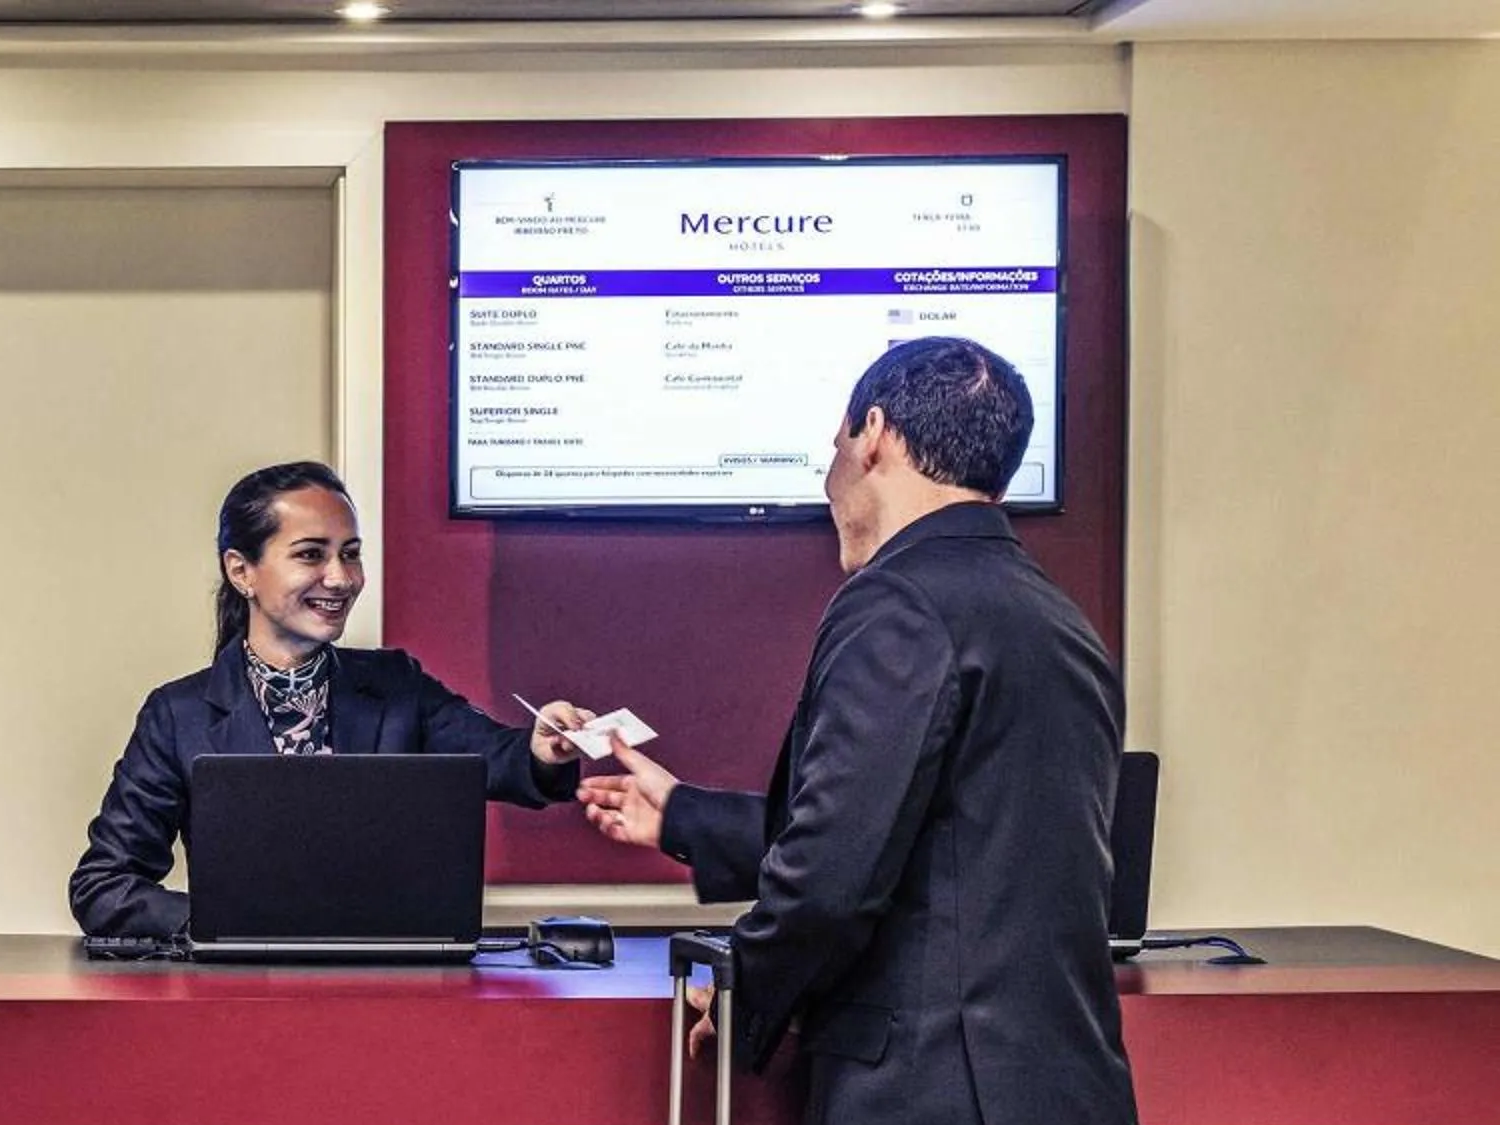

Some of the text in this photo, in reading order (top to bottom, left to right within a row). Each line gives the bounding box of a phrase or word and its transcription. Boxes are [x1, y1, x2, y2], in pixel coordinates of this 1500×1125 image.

[680, 213, 833, 235] Mercure
[532, 275, 586, 286] QUARTOS
[717, 273, 821, 286] OUTROS SERVIÇOS
[894, 270, 1039, 284] COTAÇÕES/INFORMAÇÕES
[470, 341, 525, 351] STANDARD
[469, 407, 521, 416] SUPERIOR
